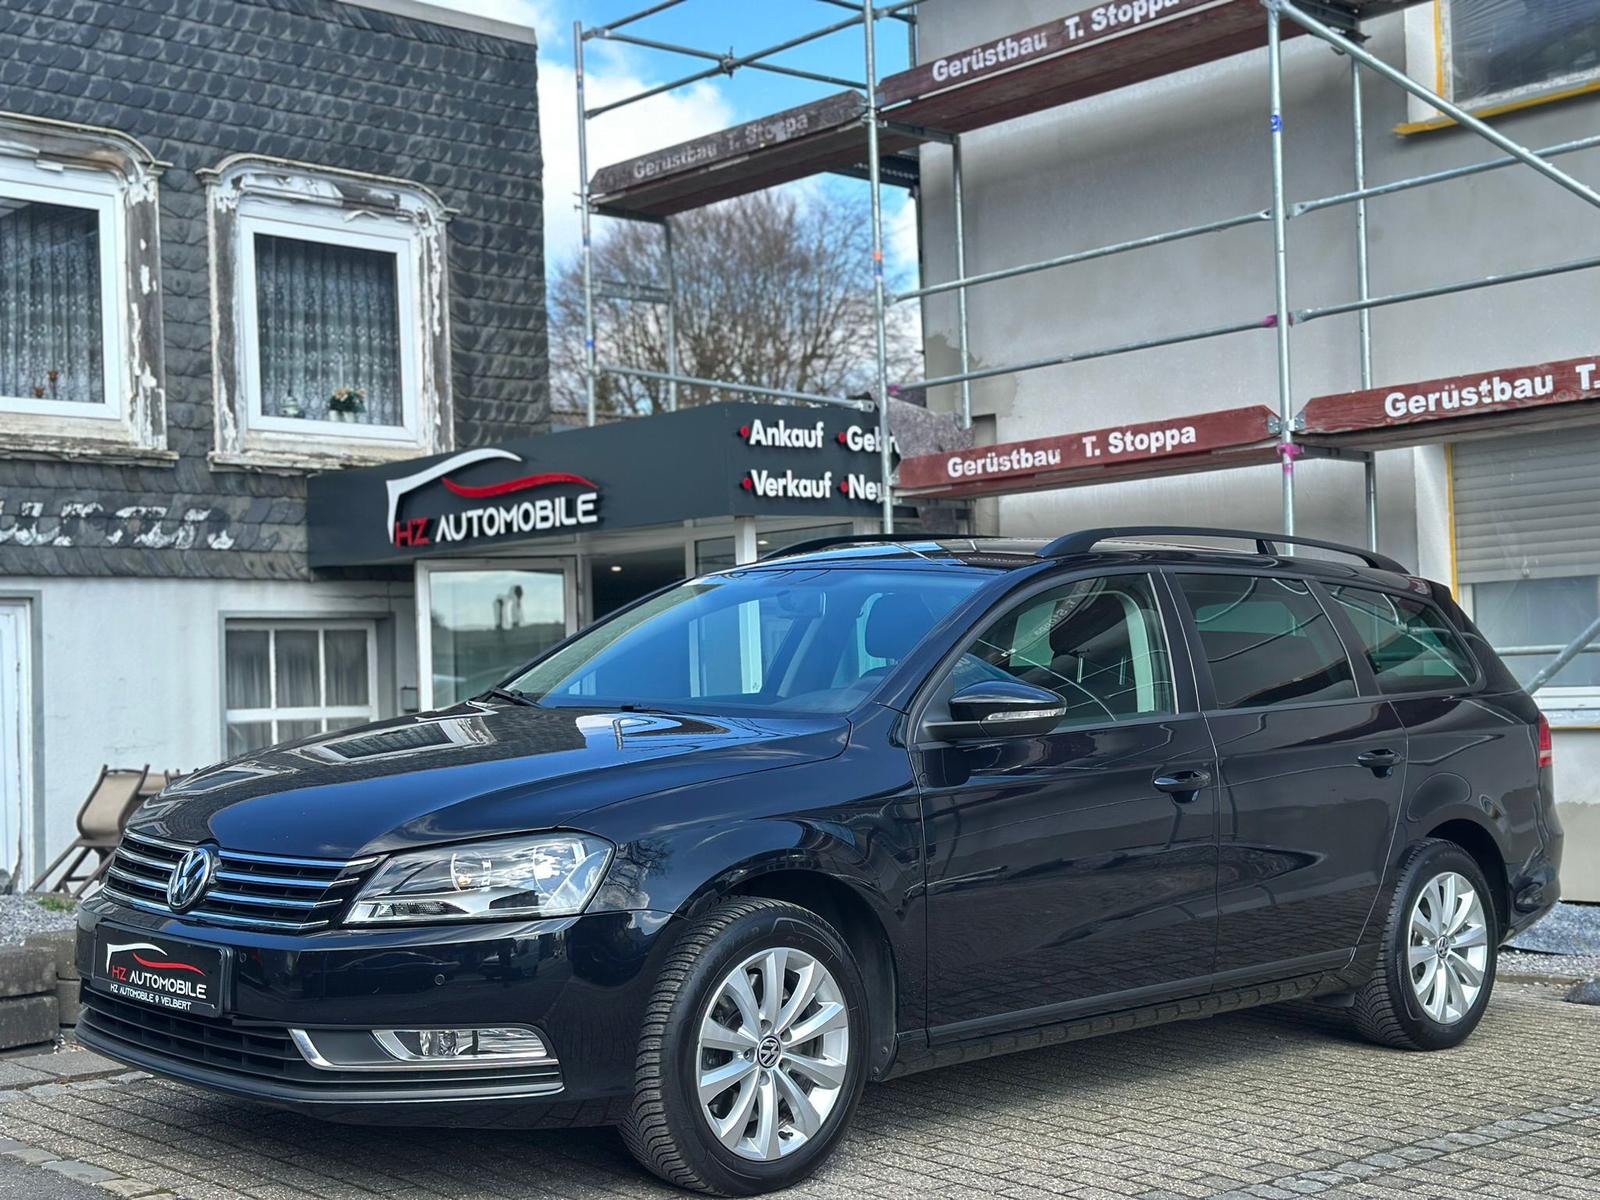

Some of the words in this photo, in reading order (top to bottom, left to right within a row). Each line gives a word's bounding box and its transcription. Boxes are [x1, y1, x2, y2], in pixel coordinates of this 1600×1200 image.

[932, 31, 1048, 82] Gerüstbau
[1064, 16, 1085, 40] T.
[1384, 373, 1554, 418] Gerüstbau
[750, 418, 825, 449] Ankauf
[947, 446, 1061, 478] Gerüstbau
[1082, 435, 1101, 458] T.
[1108, 425, 1197, 455] Stoppa
[750, 468, 832, 499] Verkauf
[395, 516, 430, 548] HZ
[435, 491, 599, 543] AUTOMOBILE
[110, 983, 119, 993] HZ
[119, 986, 154, 1003] AUTOMOBILE
[161, 996, 192, 1011] VELBERT
[112, 965, 128, 980] HZ
[129, 970, 207, 999] AUTOMOBILE
